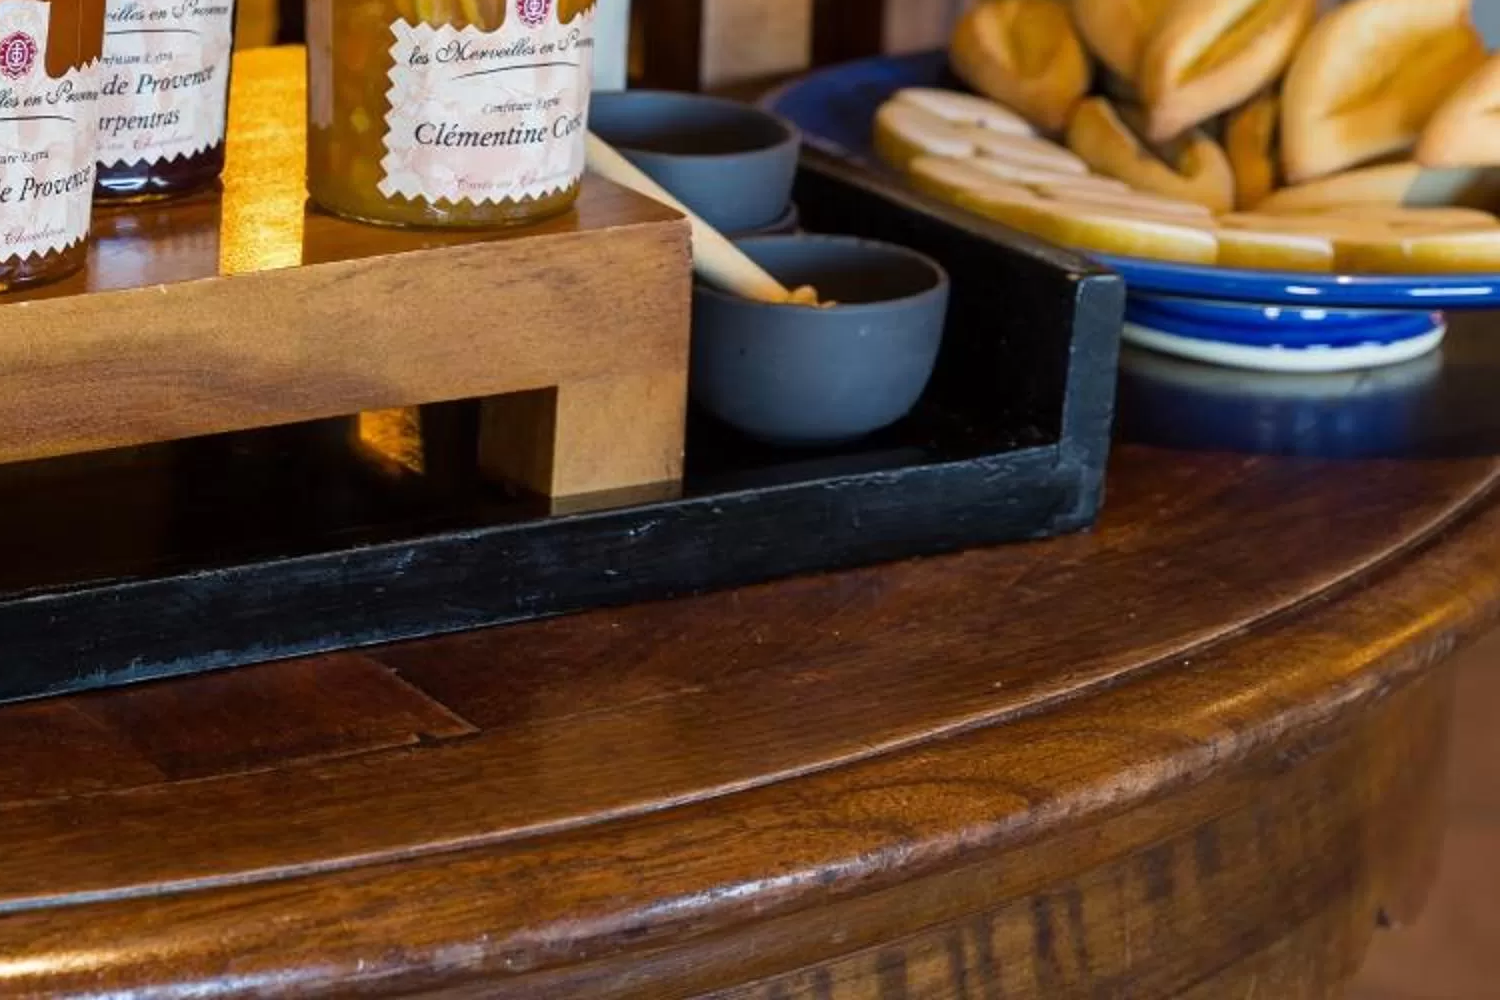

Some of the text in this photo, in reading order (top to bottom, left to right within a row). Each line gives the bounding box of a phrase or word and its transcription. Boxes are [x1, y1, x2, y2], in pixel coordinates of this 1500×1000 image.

[149, 9, 168, 20] en
[408, 46, 429, 65] les
[540, 42, 555, 55] en
[102, 73, 129, 95] de
[23, 94, 42, 108] en
[100, 109, 181, 137] rpentras
[415, 121, 549, 148] Clémentine
